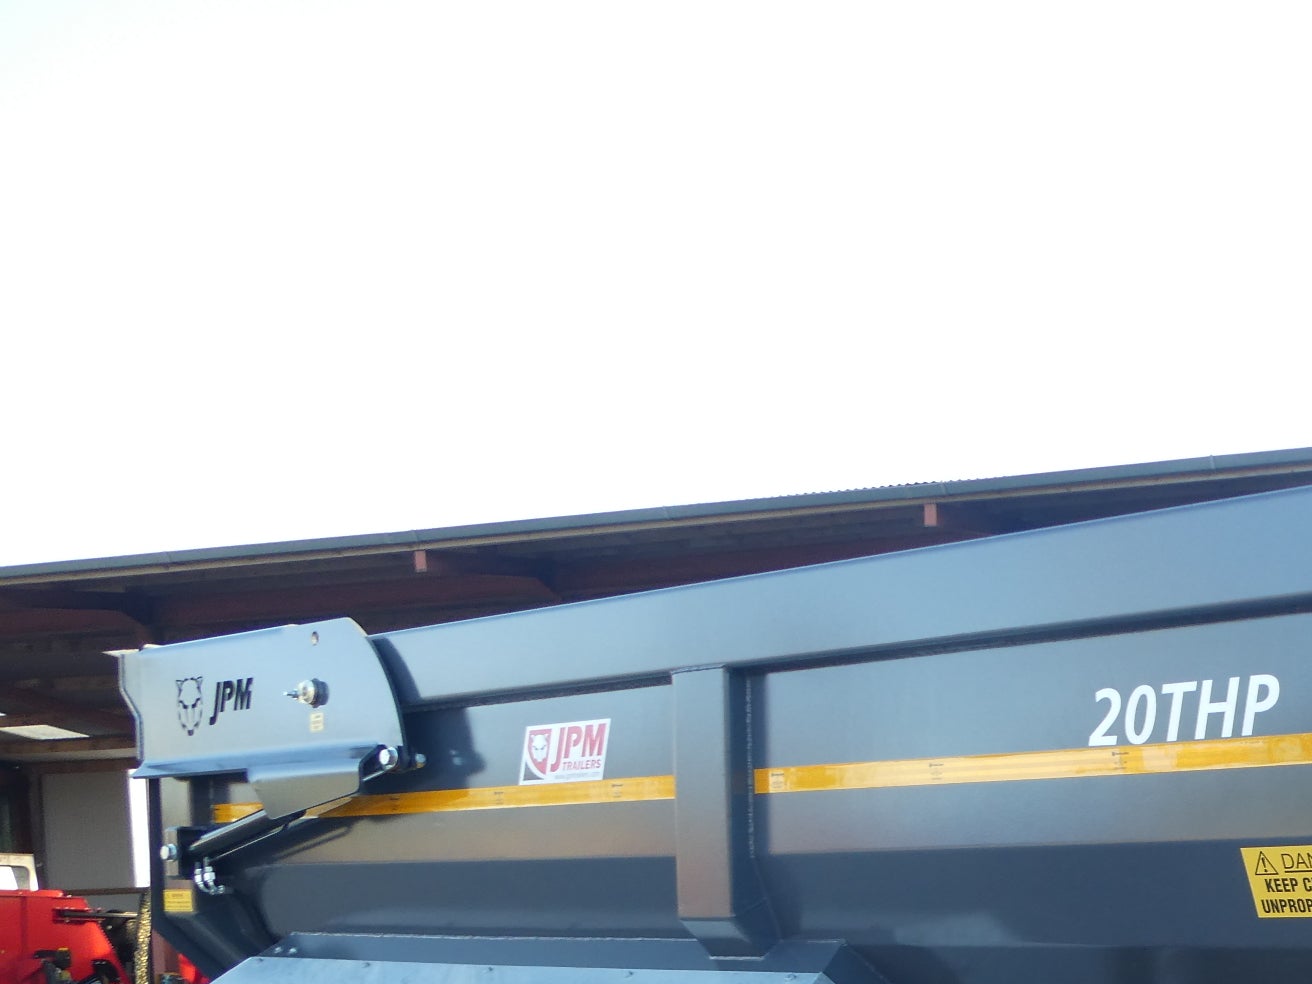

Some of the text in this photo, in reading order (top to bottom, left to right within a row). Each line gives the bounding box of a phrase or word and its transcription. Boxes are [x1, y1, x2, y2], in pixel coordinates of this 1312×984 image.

[209, 677, 254, 726] JPM
[1088, 674, 1280, 747] 20THP
[550, 723, 607, 772] JPM
[562, 759, 602, 772] TRAILERS
[1264, 877, 1299, 893] KEEP
